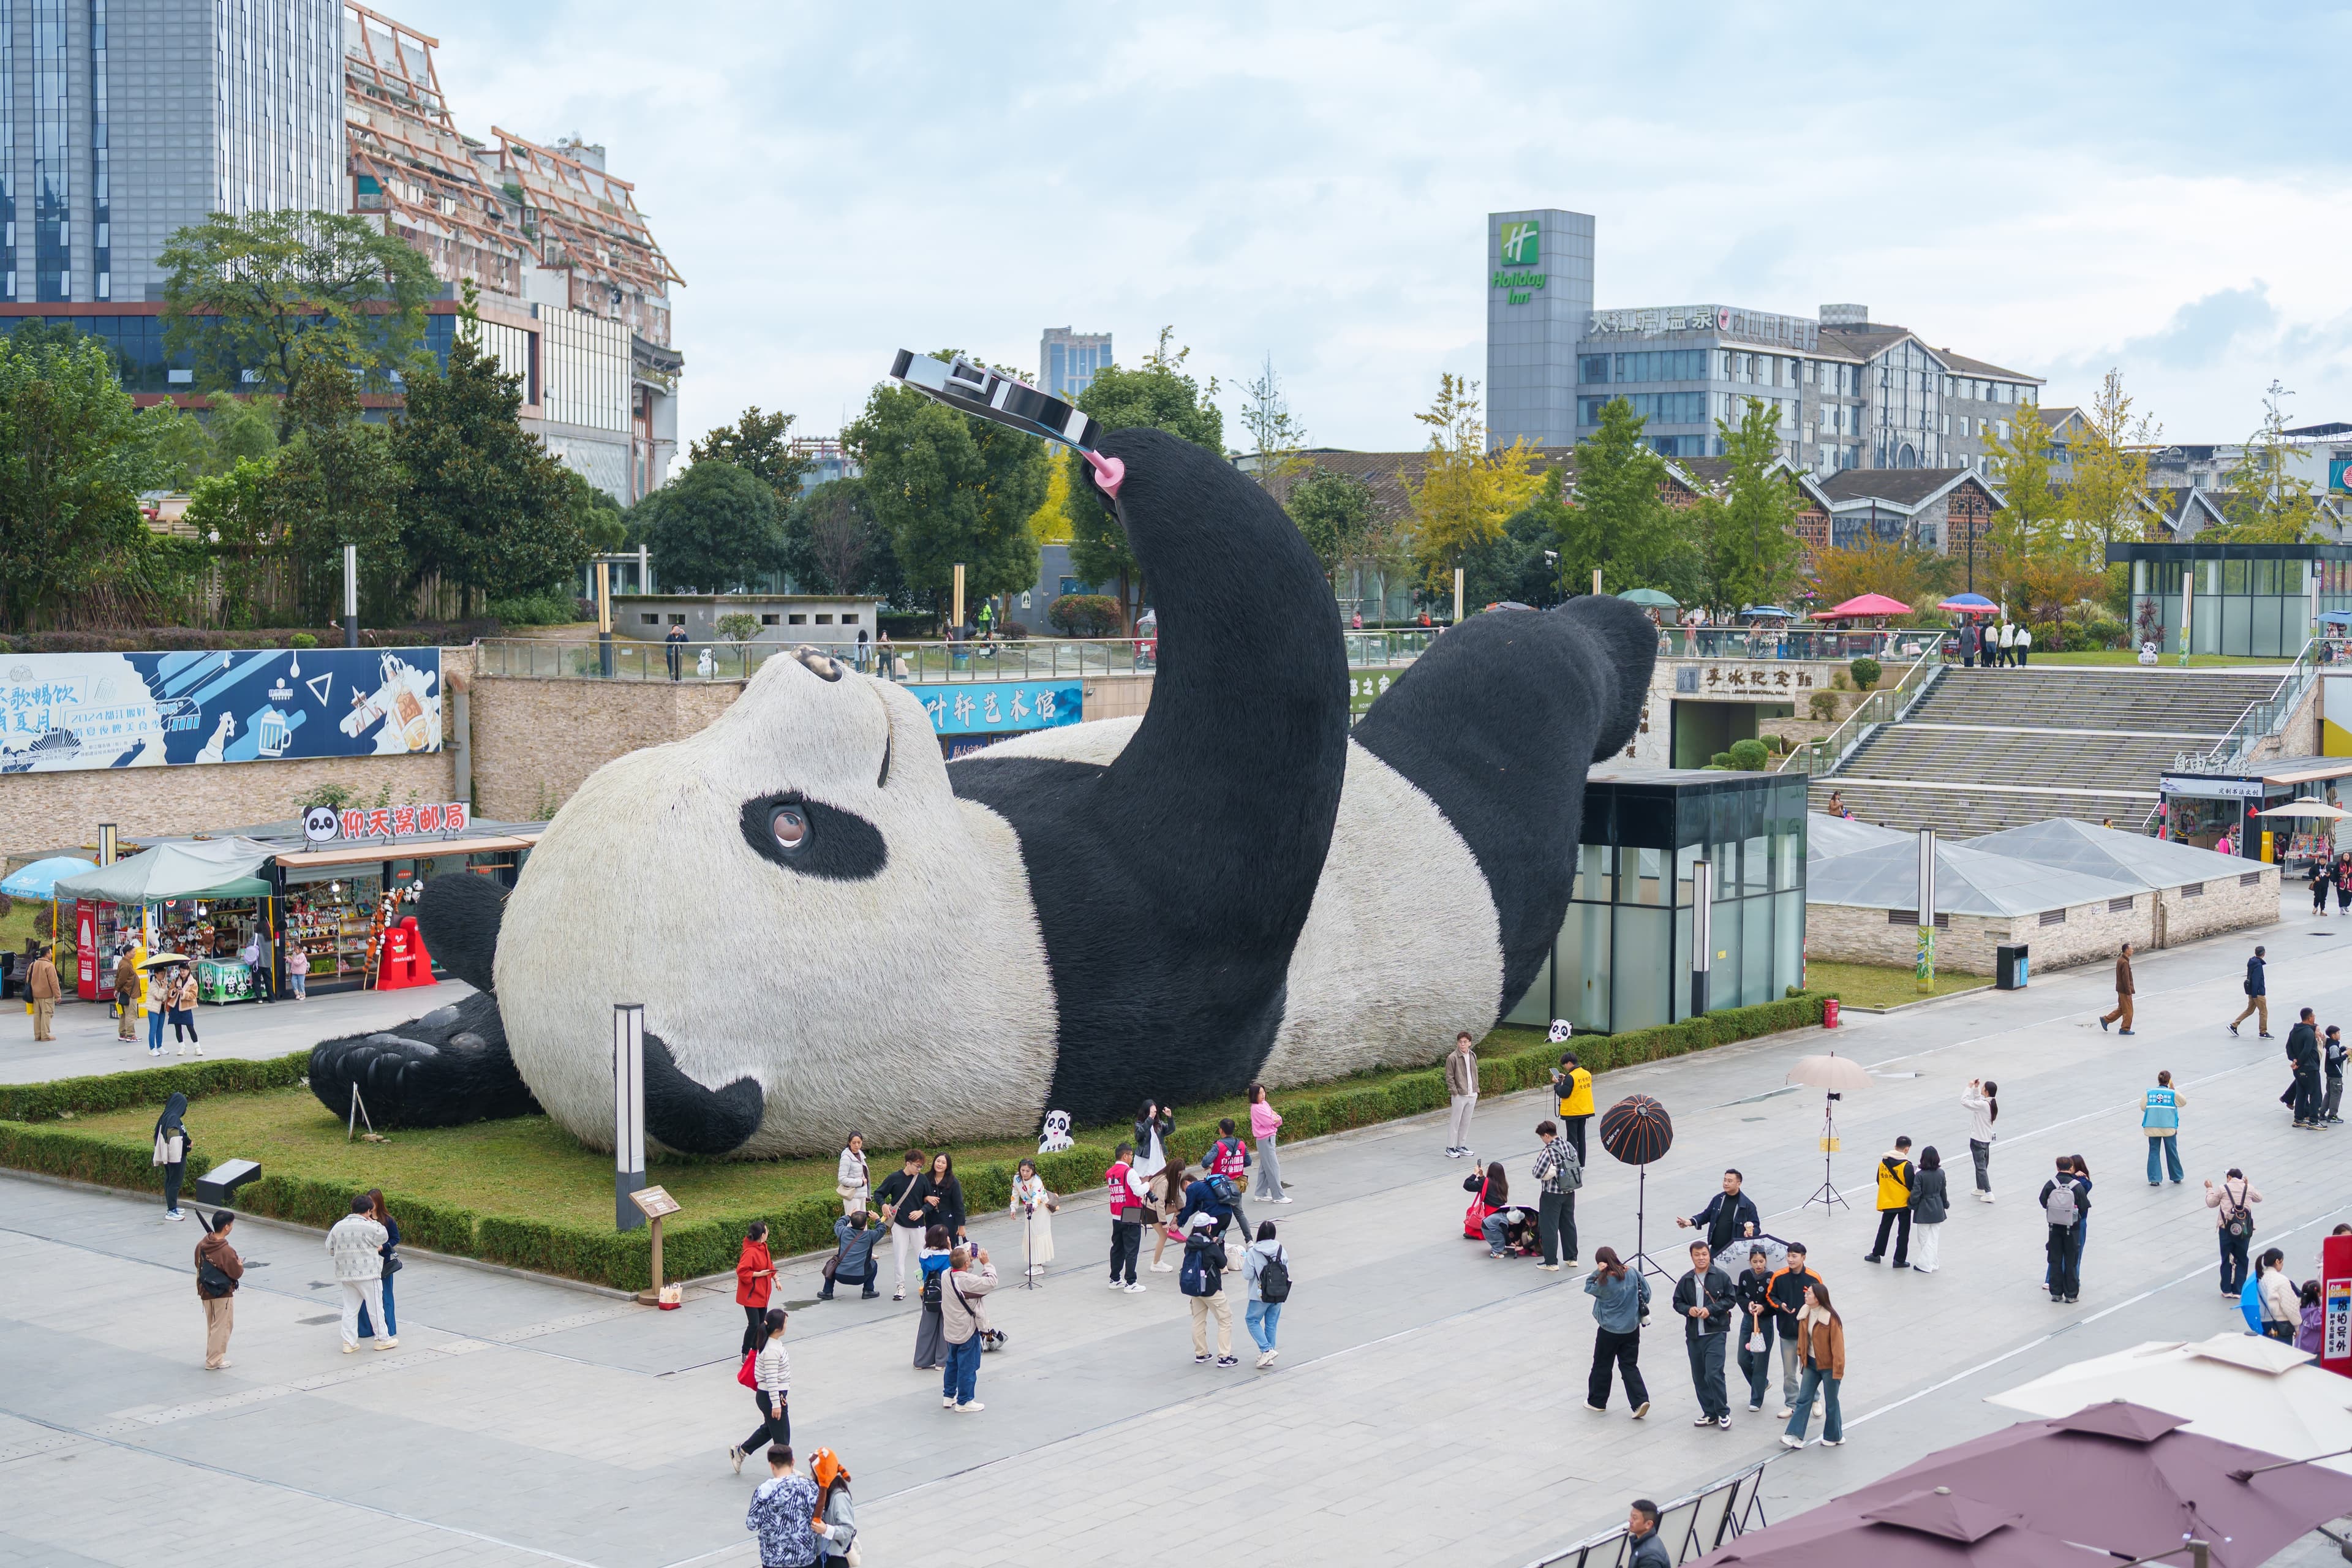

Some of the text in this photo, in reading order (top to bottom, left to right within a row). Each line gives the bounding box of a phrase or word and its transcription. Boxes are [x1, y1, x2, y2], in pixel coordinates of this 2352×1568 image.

[1491, 270, 1547, 289] Holiday
[1507, 288, 1531, 304] Inn
[1590, 307, 1713, 333] 大江户温泉
[910, 688, 1057, 729] 叶轩艺术馆
[341, 803, 466, 839] 仰天窝邮局
[2336, 1298, 2348, 1352] 旅拍号外
